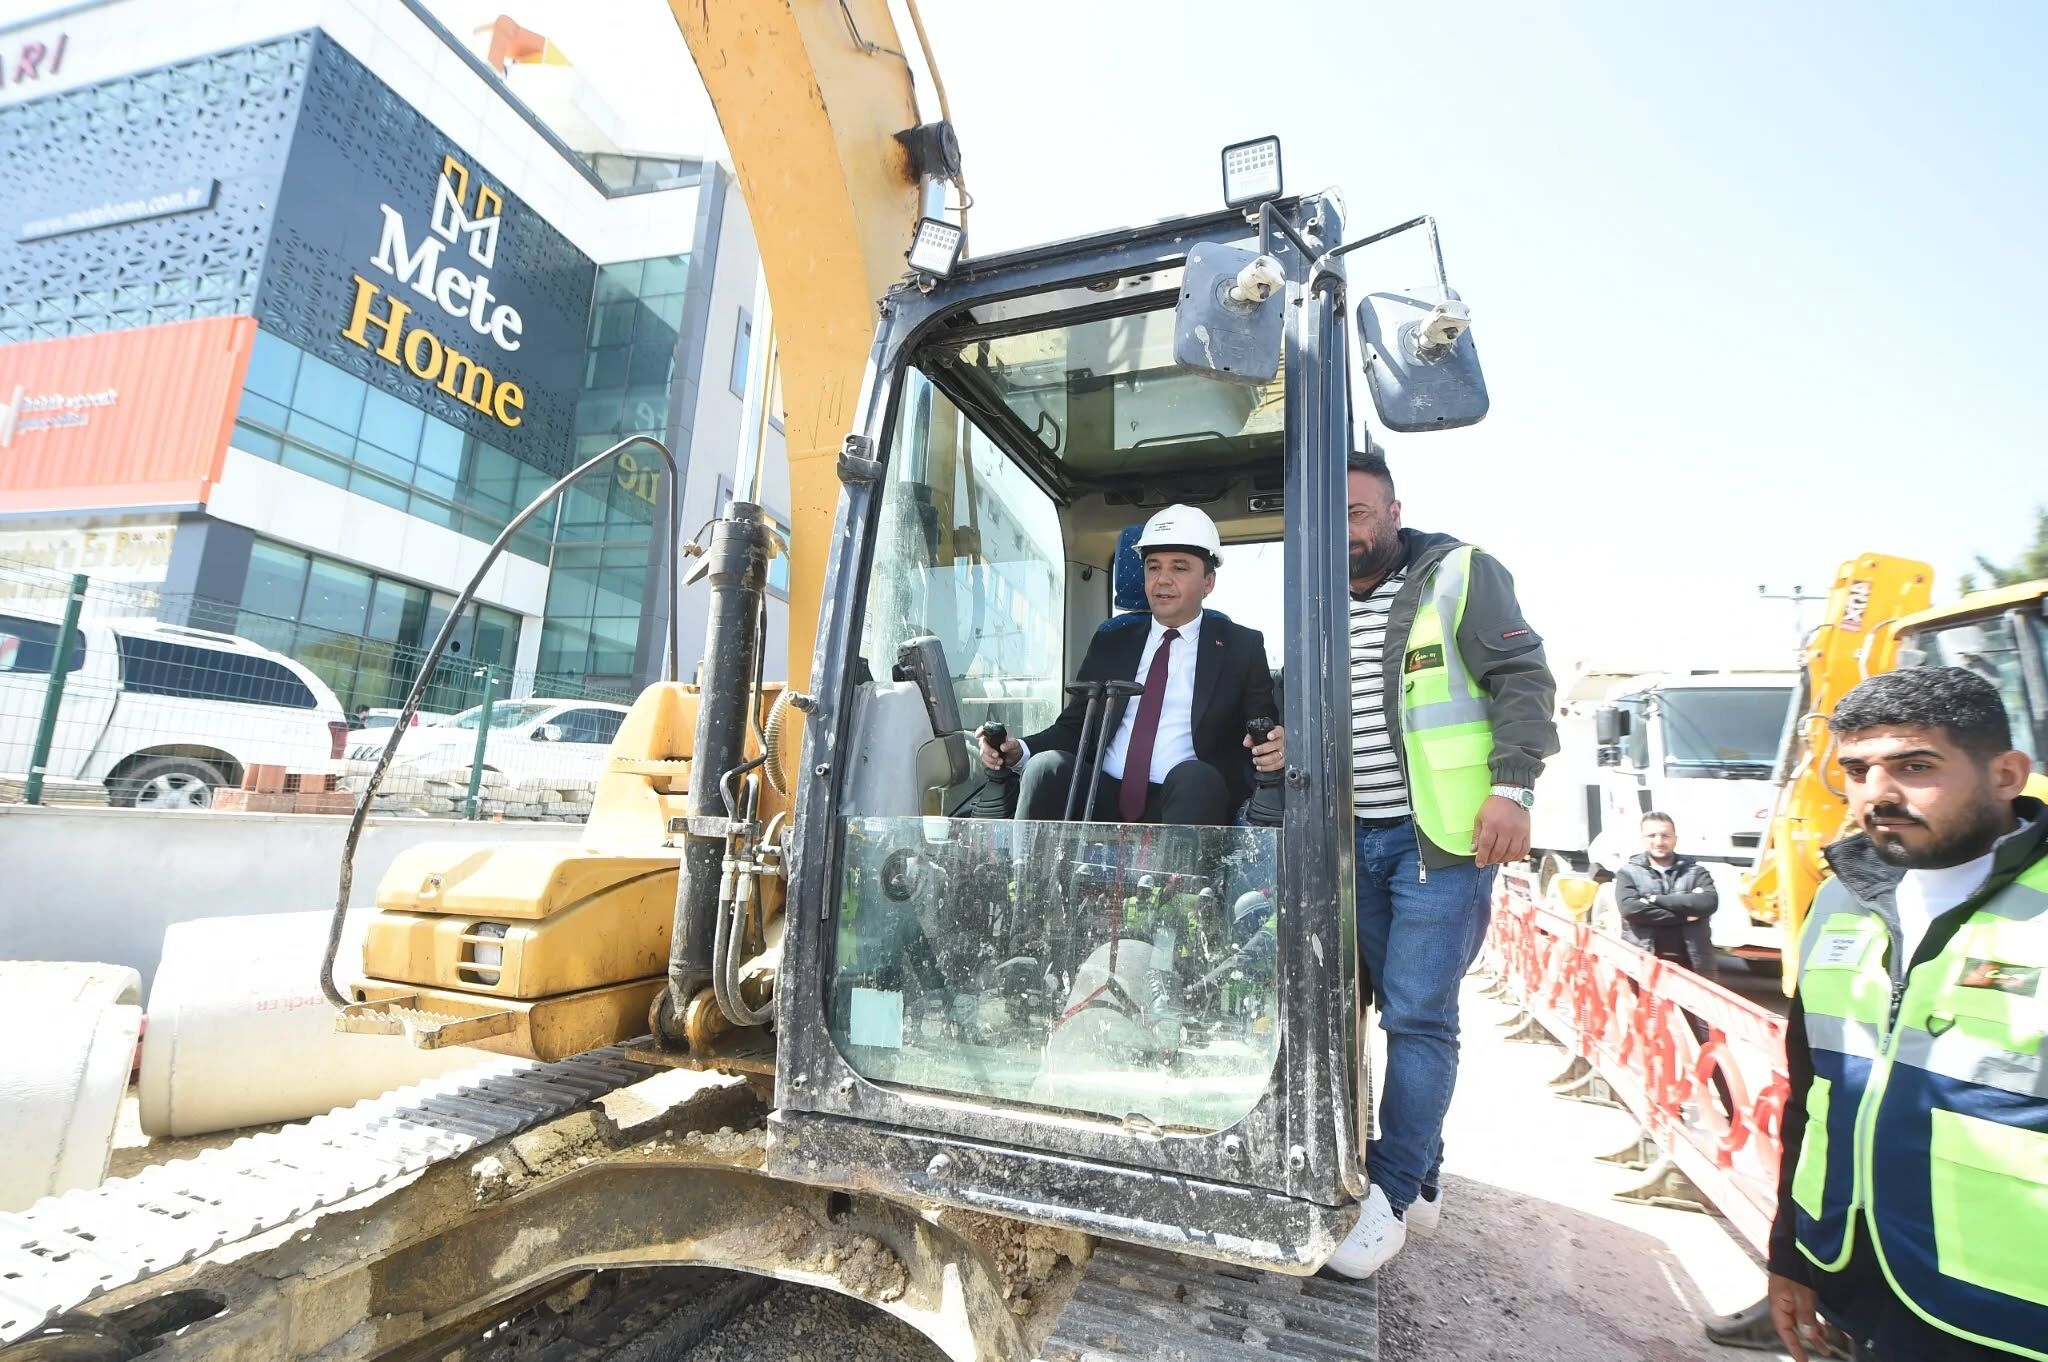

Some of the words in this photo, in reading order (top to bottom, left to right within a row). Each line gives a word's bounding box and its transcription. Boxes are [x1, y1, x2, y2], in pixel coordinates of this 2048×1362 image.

[0, 32, 69, 88] RI
[342, 273, 526, 428] Home
[369, 203, 523, 352] Mete
